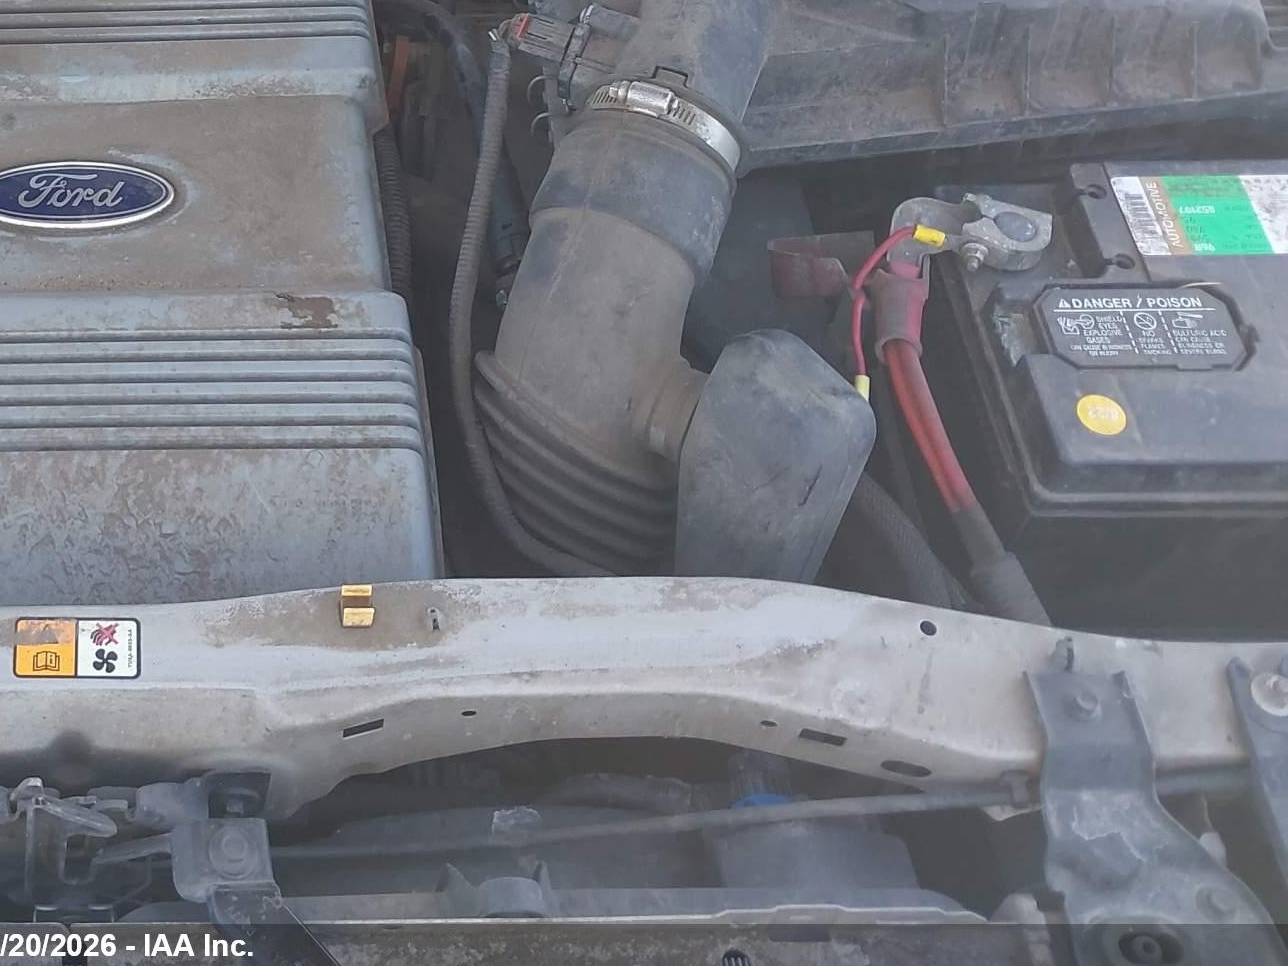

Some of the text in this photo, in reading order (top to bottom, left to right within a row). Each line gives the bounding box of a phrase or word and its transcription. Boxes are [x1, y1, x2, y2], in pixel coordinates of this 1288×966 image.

[18, 173, 125, 211] Ford
[1145, 180, 1184, 249] AUTOMOTIVE
[1071, 296, 1202, 308] DANGER / POISON
